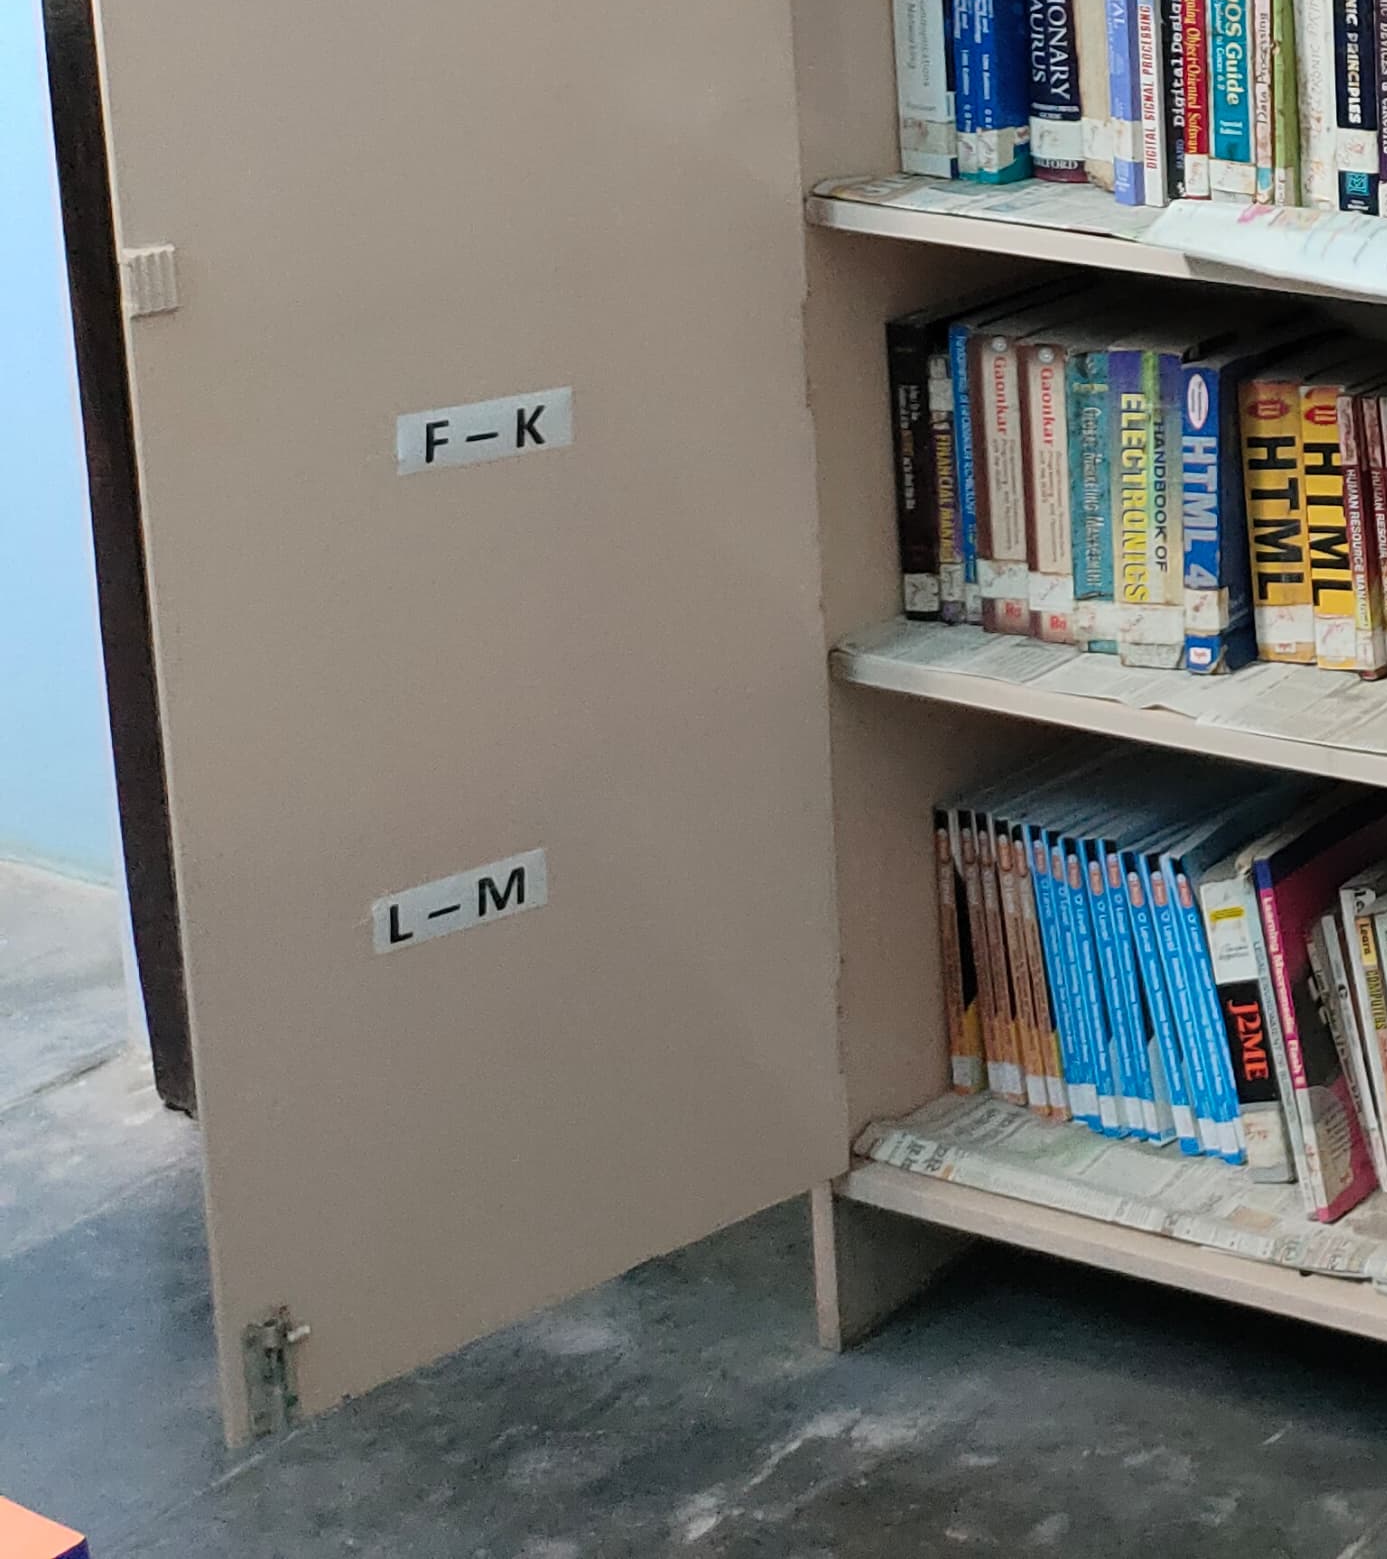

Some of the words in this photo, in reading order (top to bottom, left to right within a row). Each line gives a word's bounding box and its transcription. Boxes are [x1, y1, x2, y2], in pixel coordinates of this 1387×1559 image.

[1225, 44, 1242, 105] Guide
[993, 356, 1008, 435] Gaonkar
[1040, 368, 1055, 447] Gaonkar
[1120, 392, 1151, 603] ELECTRONICS
[1182, 435, 1219, 560] HTML
[1247, 435, 1304, 600] HTML
[1303, 442, 1355, 606] HTML
[1227, 1000, 1269, 1080] J2ME
